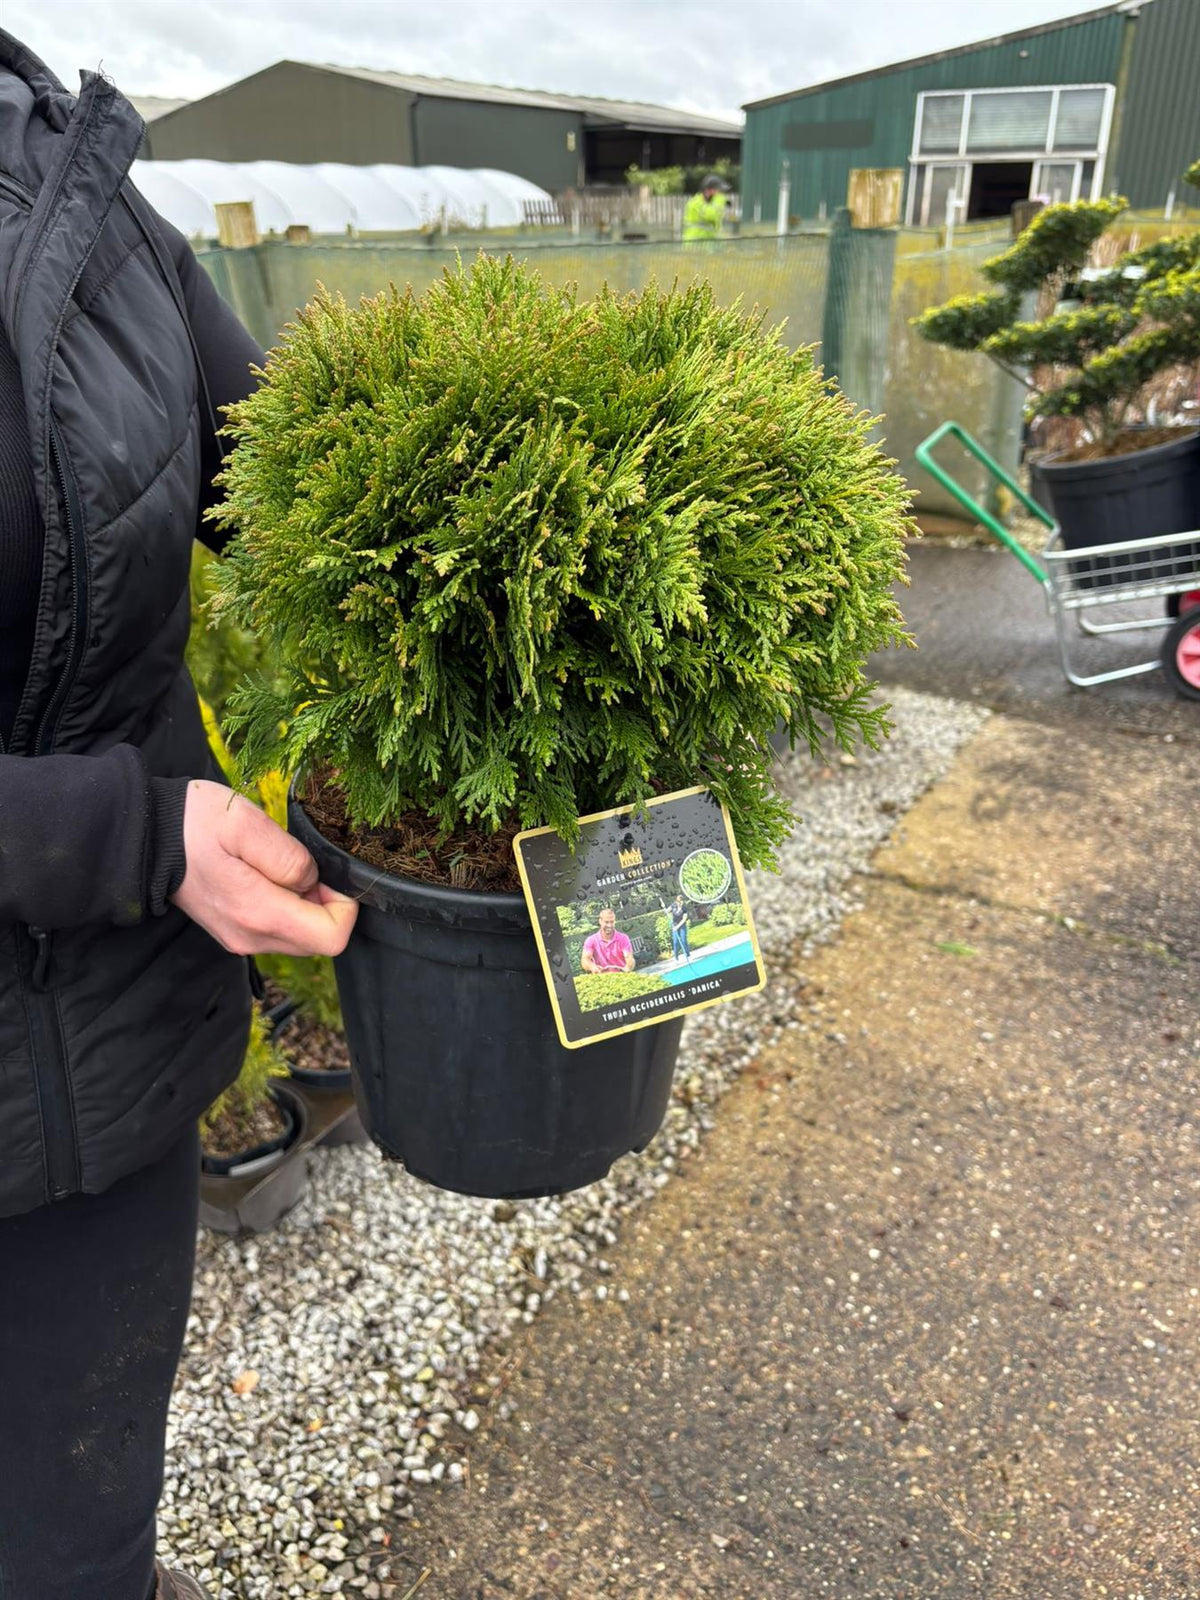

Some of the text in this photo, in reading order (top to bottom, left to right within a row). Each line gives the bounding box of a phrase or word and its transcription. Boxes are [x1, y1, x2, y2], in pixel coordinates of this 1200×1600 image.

[596, 873, 626, 887] GARDEN
[602, 1008, 628, 1022] THUJA
[631, 990, 686, 1013] OCCIDENTALIS
